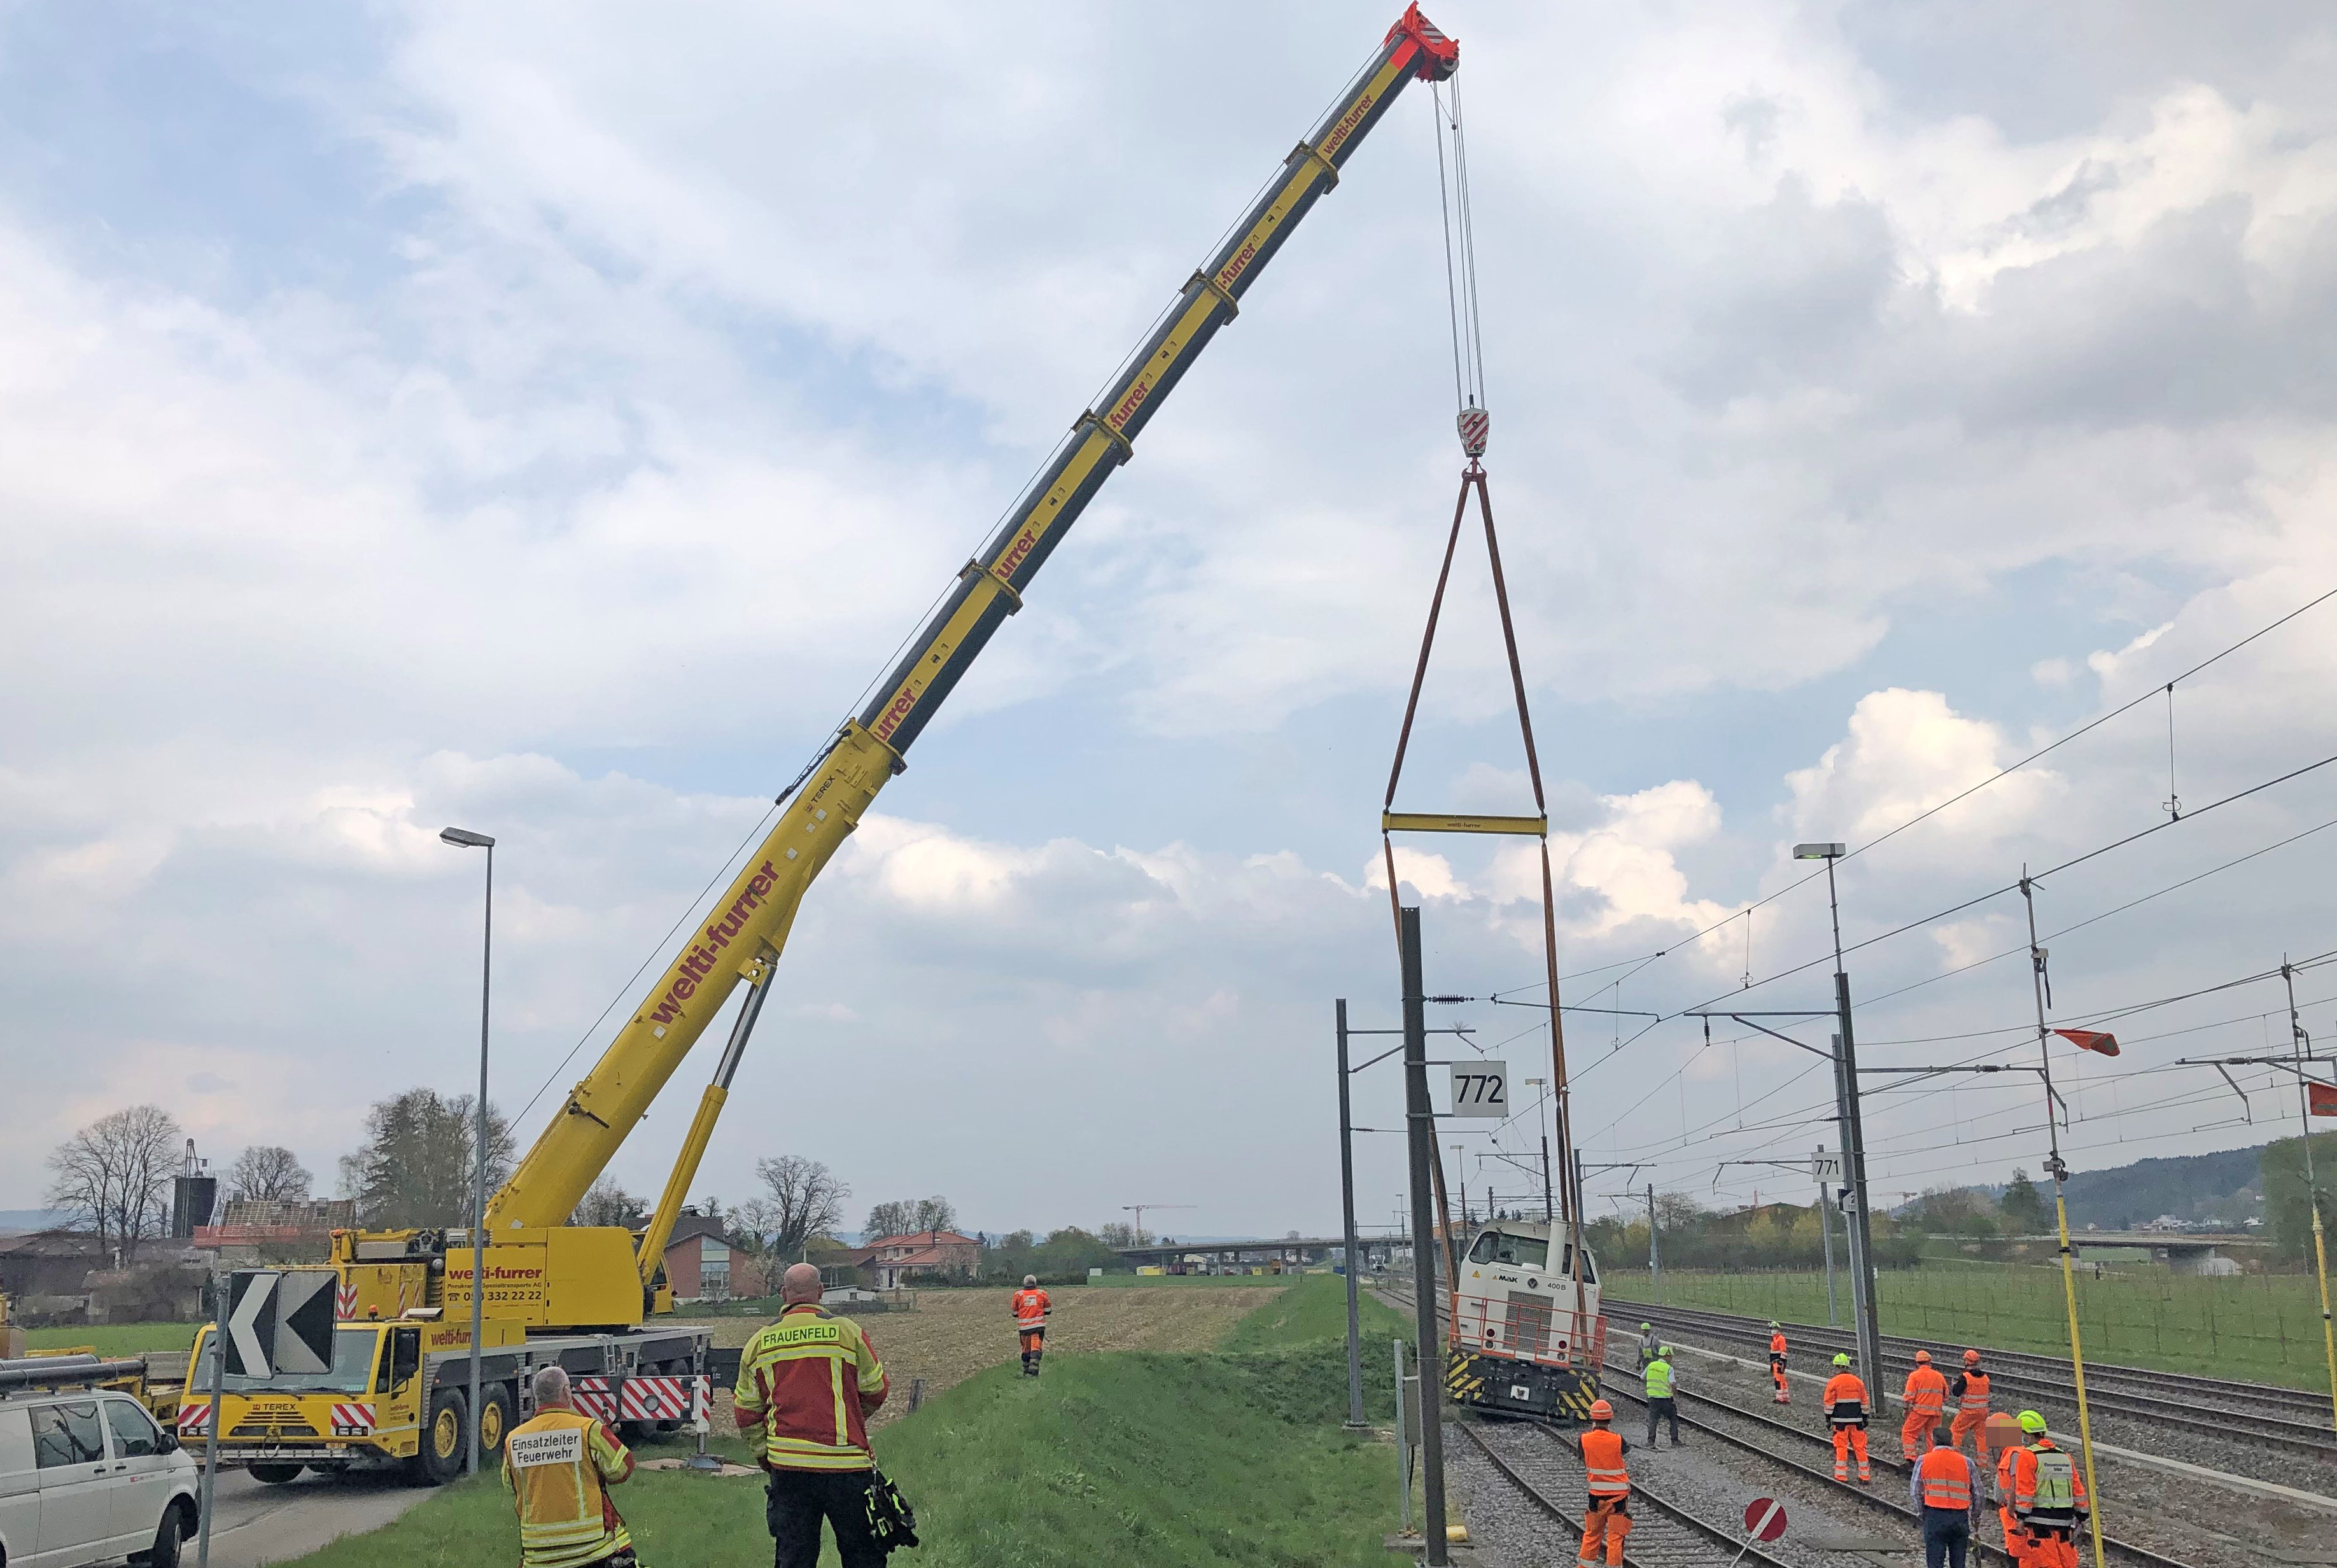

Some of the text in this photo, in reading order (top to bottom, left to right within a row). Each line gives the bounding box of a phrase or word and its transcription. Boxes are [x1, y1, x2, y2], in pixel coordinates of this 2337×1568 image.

[1323, 94, 1373, 155] welti-furrer
[811, 774, 836, 803] TEREX
[649, 859, 780, 1025] welti-furrer
[1455, 1075, 1504, 1103] 772
[1815, 1159, 1839, 1175] 771
[488, 1291, 509, 1301] 332
[512, 1291, 525, 1300] 22
[528, 1291, 542, 1300] 22
[764, 1327, 837, 1347] FRAUENFELD
[512, 1434, 579, 1451] Einsatzleiter
[517, 1447, 573, 1464] Feuerwehr
